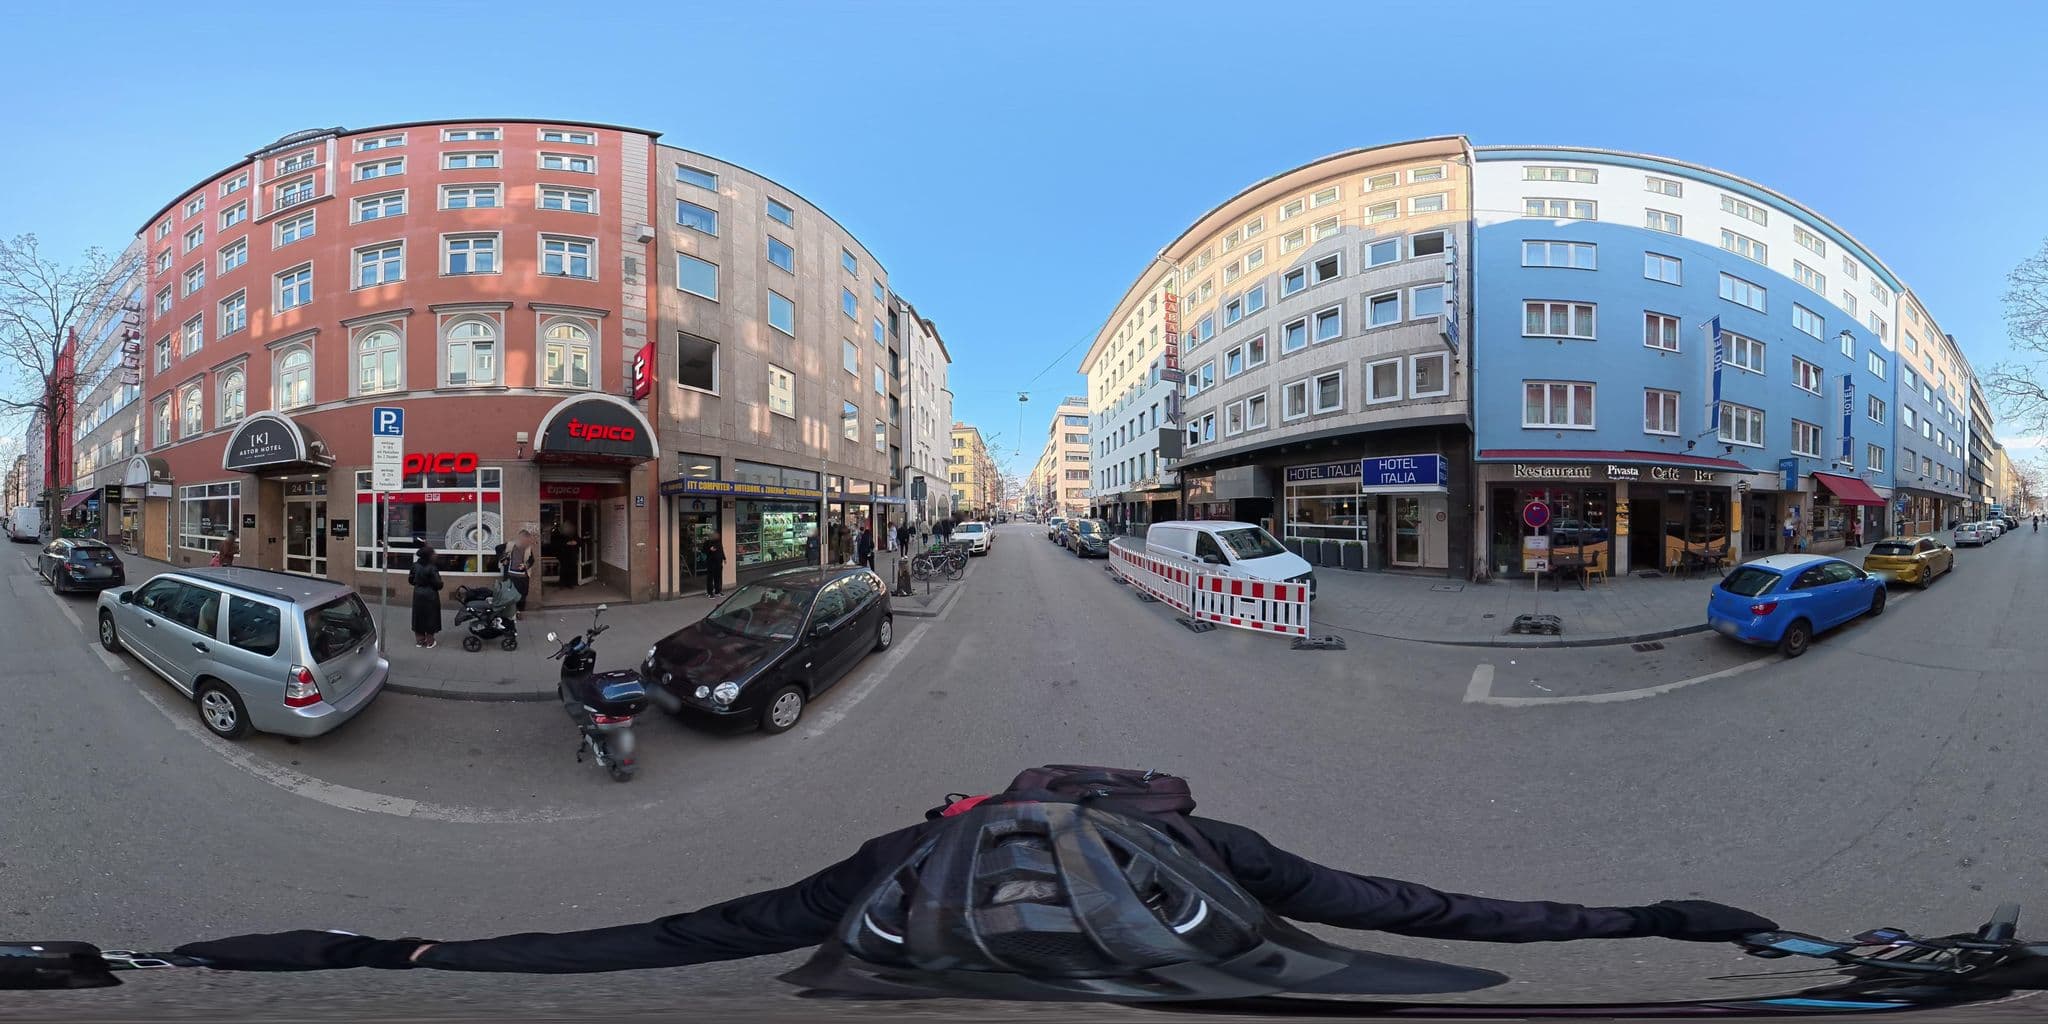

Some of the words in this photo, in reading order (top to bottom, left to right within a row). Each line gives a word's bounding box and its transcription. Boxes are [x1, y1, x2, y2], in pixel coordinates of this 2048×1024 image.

[1166, 294, 1178, 368] CABARET
[1714, 334, 1722, 373] HOTEL
[381, 411, 396, 432] P
[568, 418, 636, 441] tipico
[240, 448, 259, 456] ASTOR
[402, 452, 479, 480] pico
[1290, 466, 1324, 480] HOTEL
[1327, 463, 1362, 477] ITALIA
[1379, 458, 1418, 470] HOTEL
[1513, 463, 1591, 478] Restaurant
[1607, 464, 1639, 476] Pivasta
[1651, 466, 1680, 480] Café
[1694, 470, 1714, 482] Bar
[699, 482, 730, 492] COMPUTER
[1381, 472, 1416, 484] ITALIA
[291, 485, 302, 493] 24
